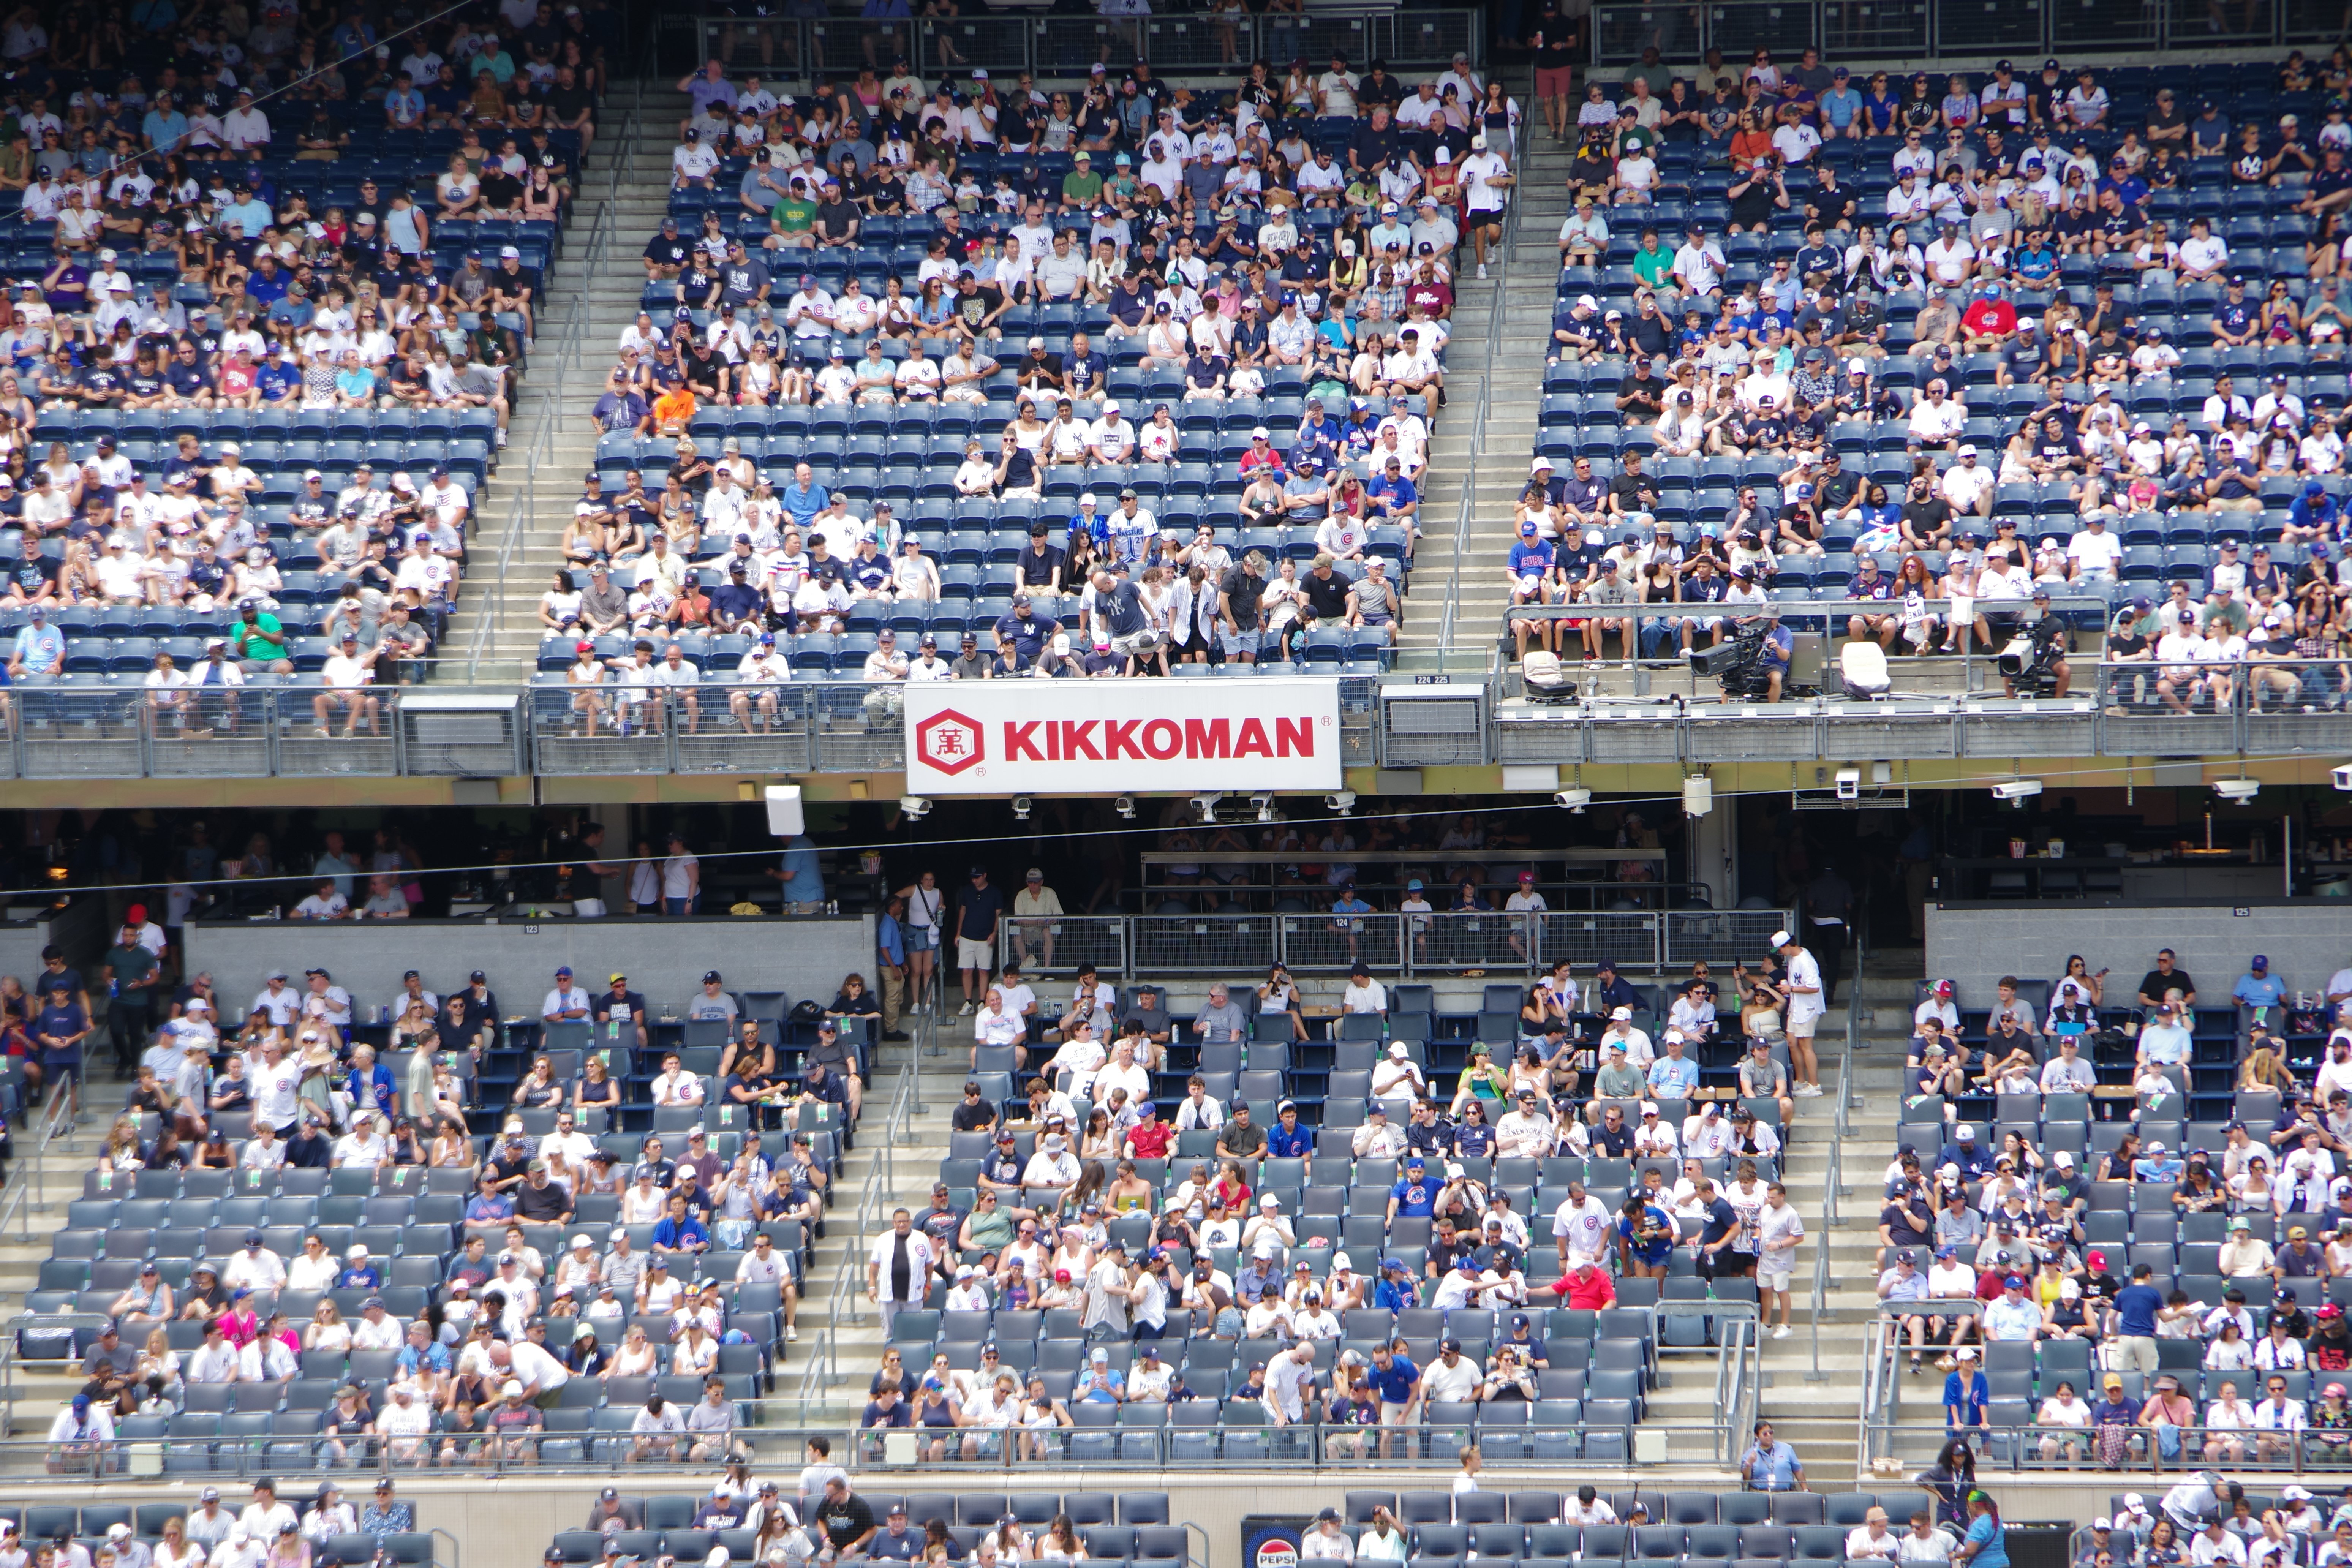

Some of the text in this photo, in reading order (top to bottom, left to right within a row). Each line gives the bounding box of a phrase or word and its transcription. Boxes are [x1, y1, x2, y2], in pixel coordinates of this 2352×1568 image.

[775, 152, 789, 161] YORK
[1415, 293, 1440, 304] Pepper
[470, 384, 486, 394] YORK
[1381, 488, 1398, 498] CUBS
[1118, 526, 1144, 537] BAYSTARS
[1521, 556, 1544, 568] CUBS
[28, 640, 33, 648] 4
[1003, 669, 1023, 678] Yankees
[1004, 717, 1314, 761] KIKKOMAN
[183, 1028, 201, 1039] CUBS
[1512, 1127, 1541, 1136] NEW YORK
[1090, 1272, 1097, 1290] 99
[499, 1412, 528, 1421] CUBS
[1260, 1555, 1295, 1564] PEPSI
